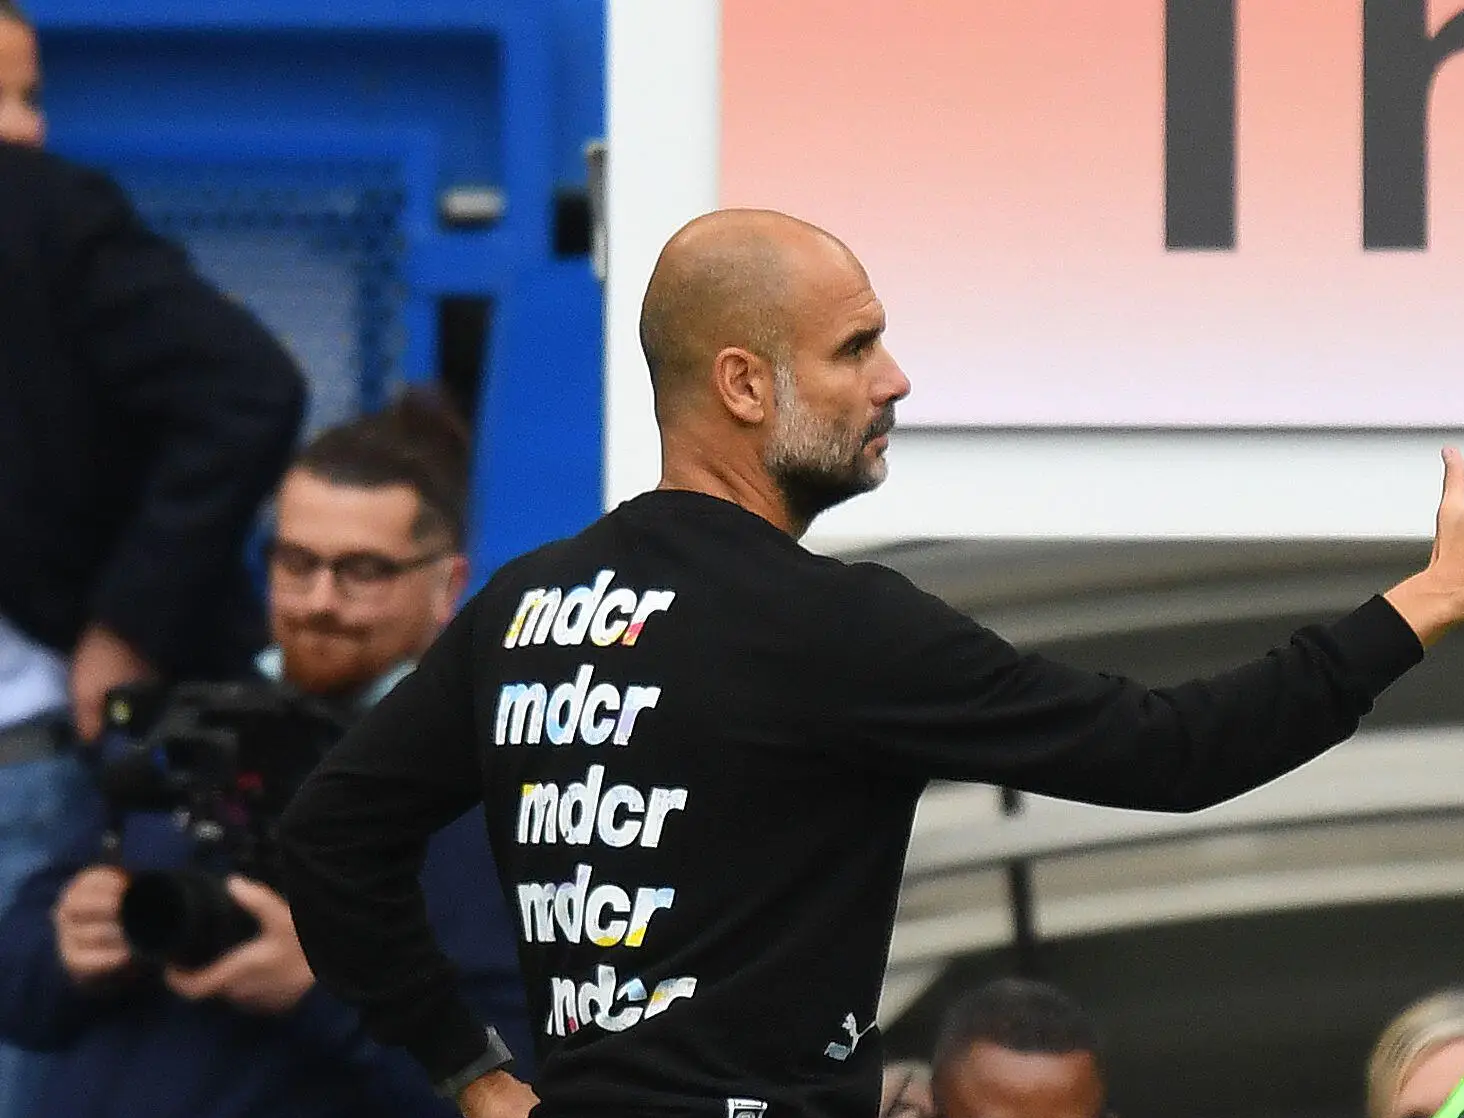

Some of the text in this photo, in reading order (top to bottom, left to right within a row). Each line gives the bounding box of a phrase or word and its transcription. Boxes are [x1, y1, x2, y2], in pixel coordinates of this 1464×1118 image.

[503, 568, 675, 648] mdcr
[494, 664, 661, 745] mdcr
[516, 764, 688, 848] mdcr
[517, 864, 675, 947] mdcr
